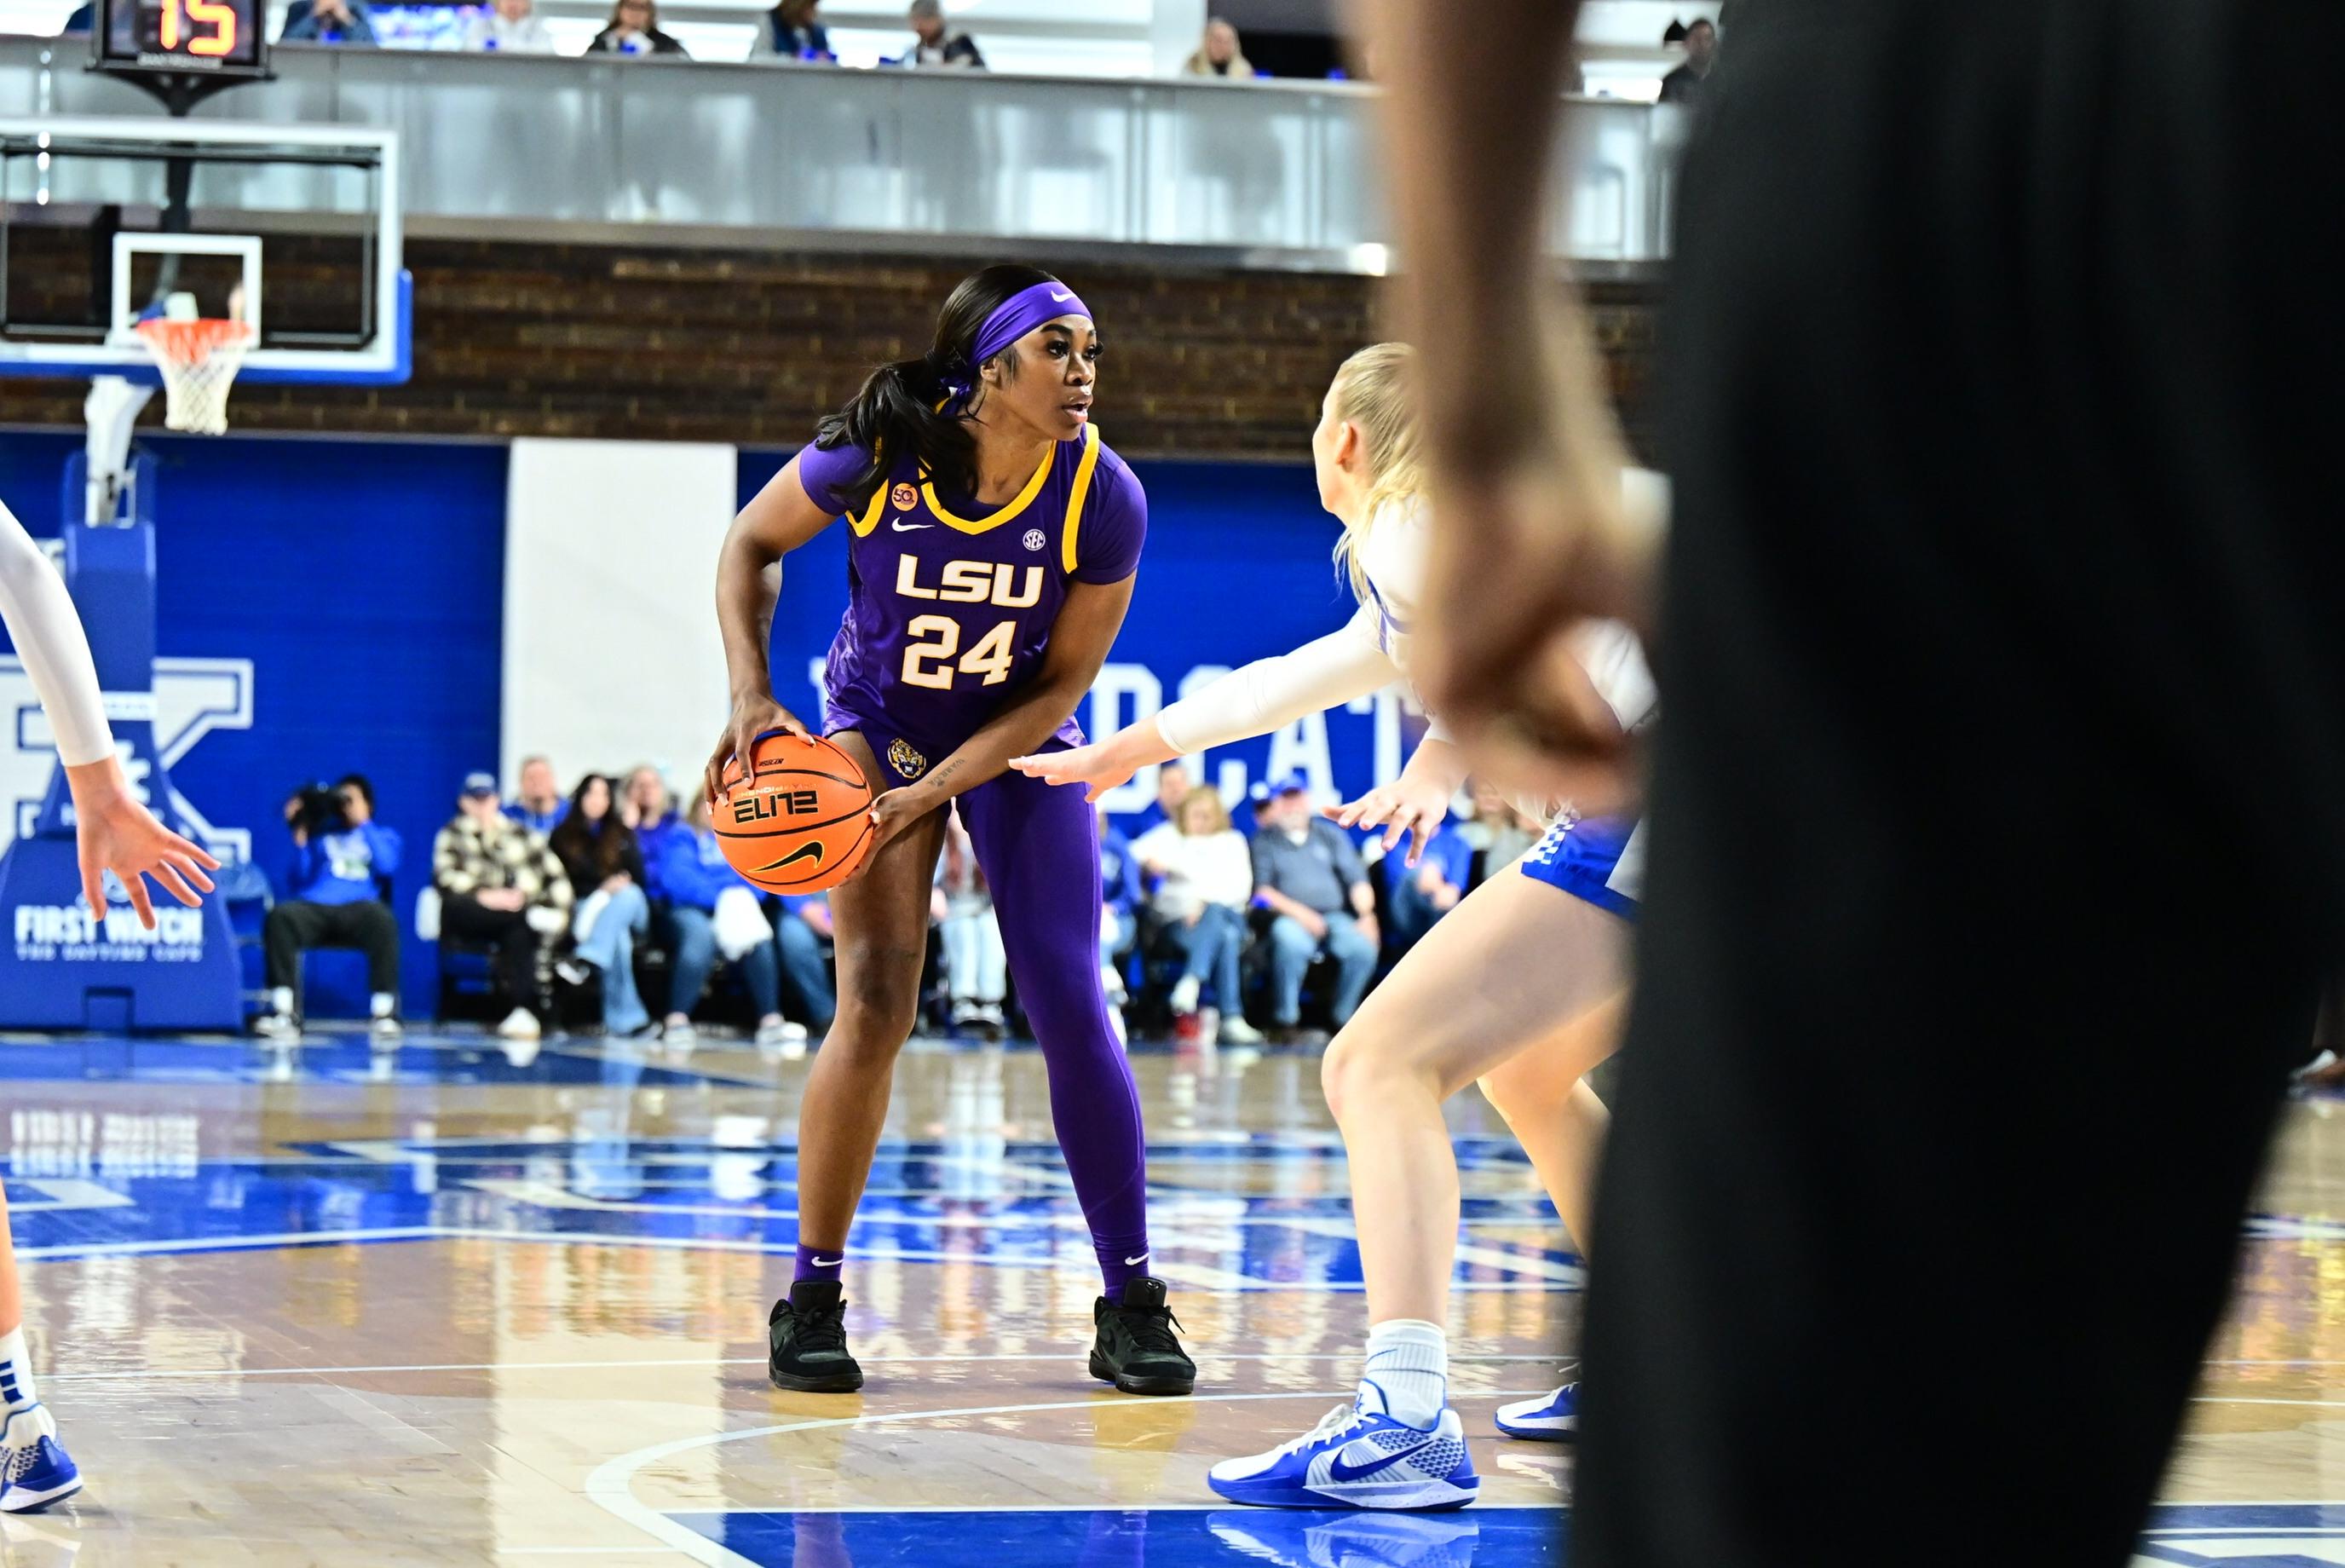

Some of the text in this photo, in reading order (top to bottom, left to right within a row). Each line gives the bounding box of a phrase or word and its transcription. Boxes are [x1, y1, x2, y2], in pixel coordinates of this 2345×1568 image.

[161, 0, 235, 55] 15
[1024, 530, 1045, 550] SEC
[896, 553, 1045, 608] LSU
[901, 614, 1017, 690] 24
[734, 790, 819, 824] ELITE
